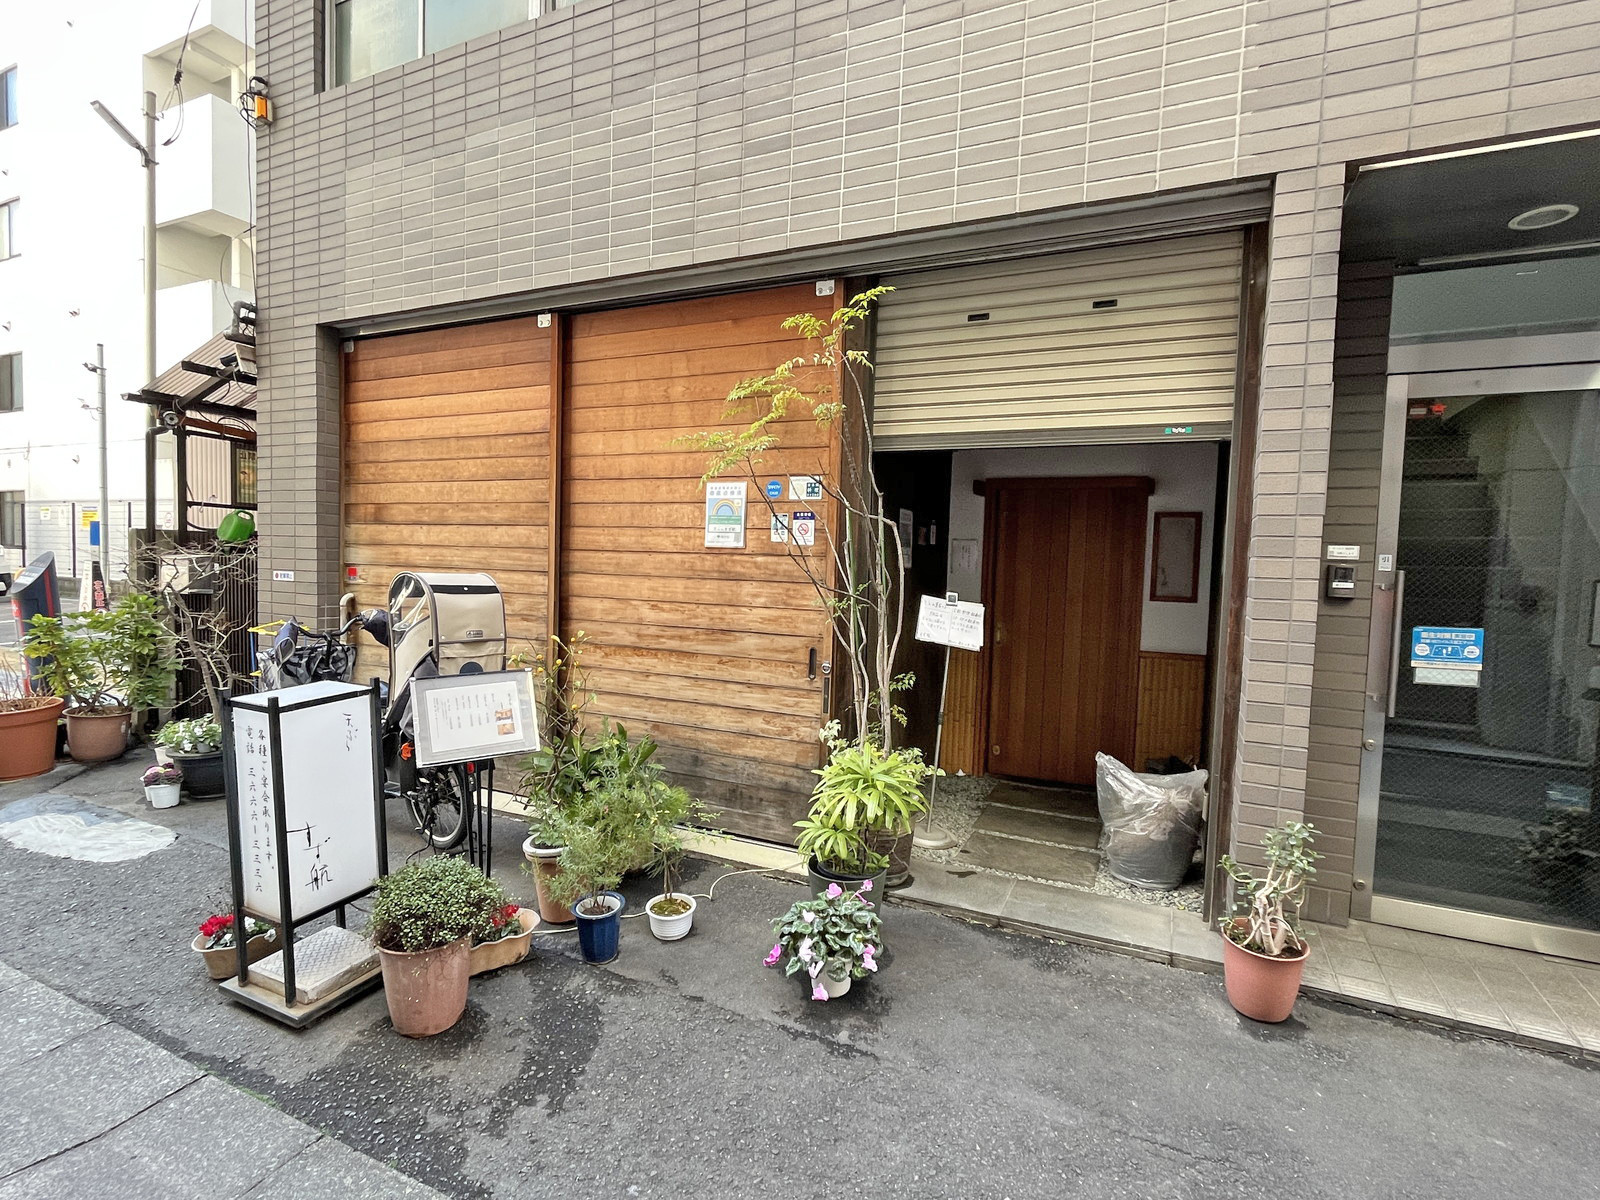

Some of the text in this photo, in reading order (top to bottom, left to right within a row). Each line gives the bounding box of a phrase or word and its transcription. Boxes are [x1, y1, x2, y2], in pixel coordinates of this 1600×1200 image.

[343, 712, 359, 752] 天ぷら
[257, 729, 275, 870] 各種ご宴会承ります。
